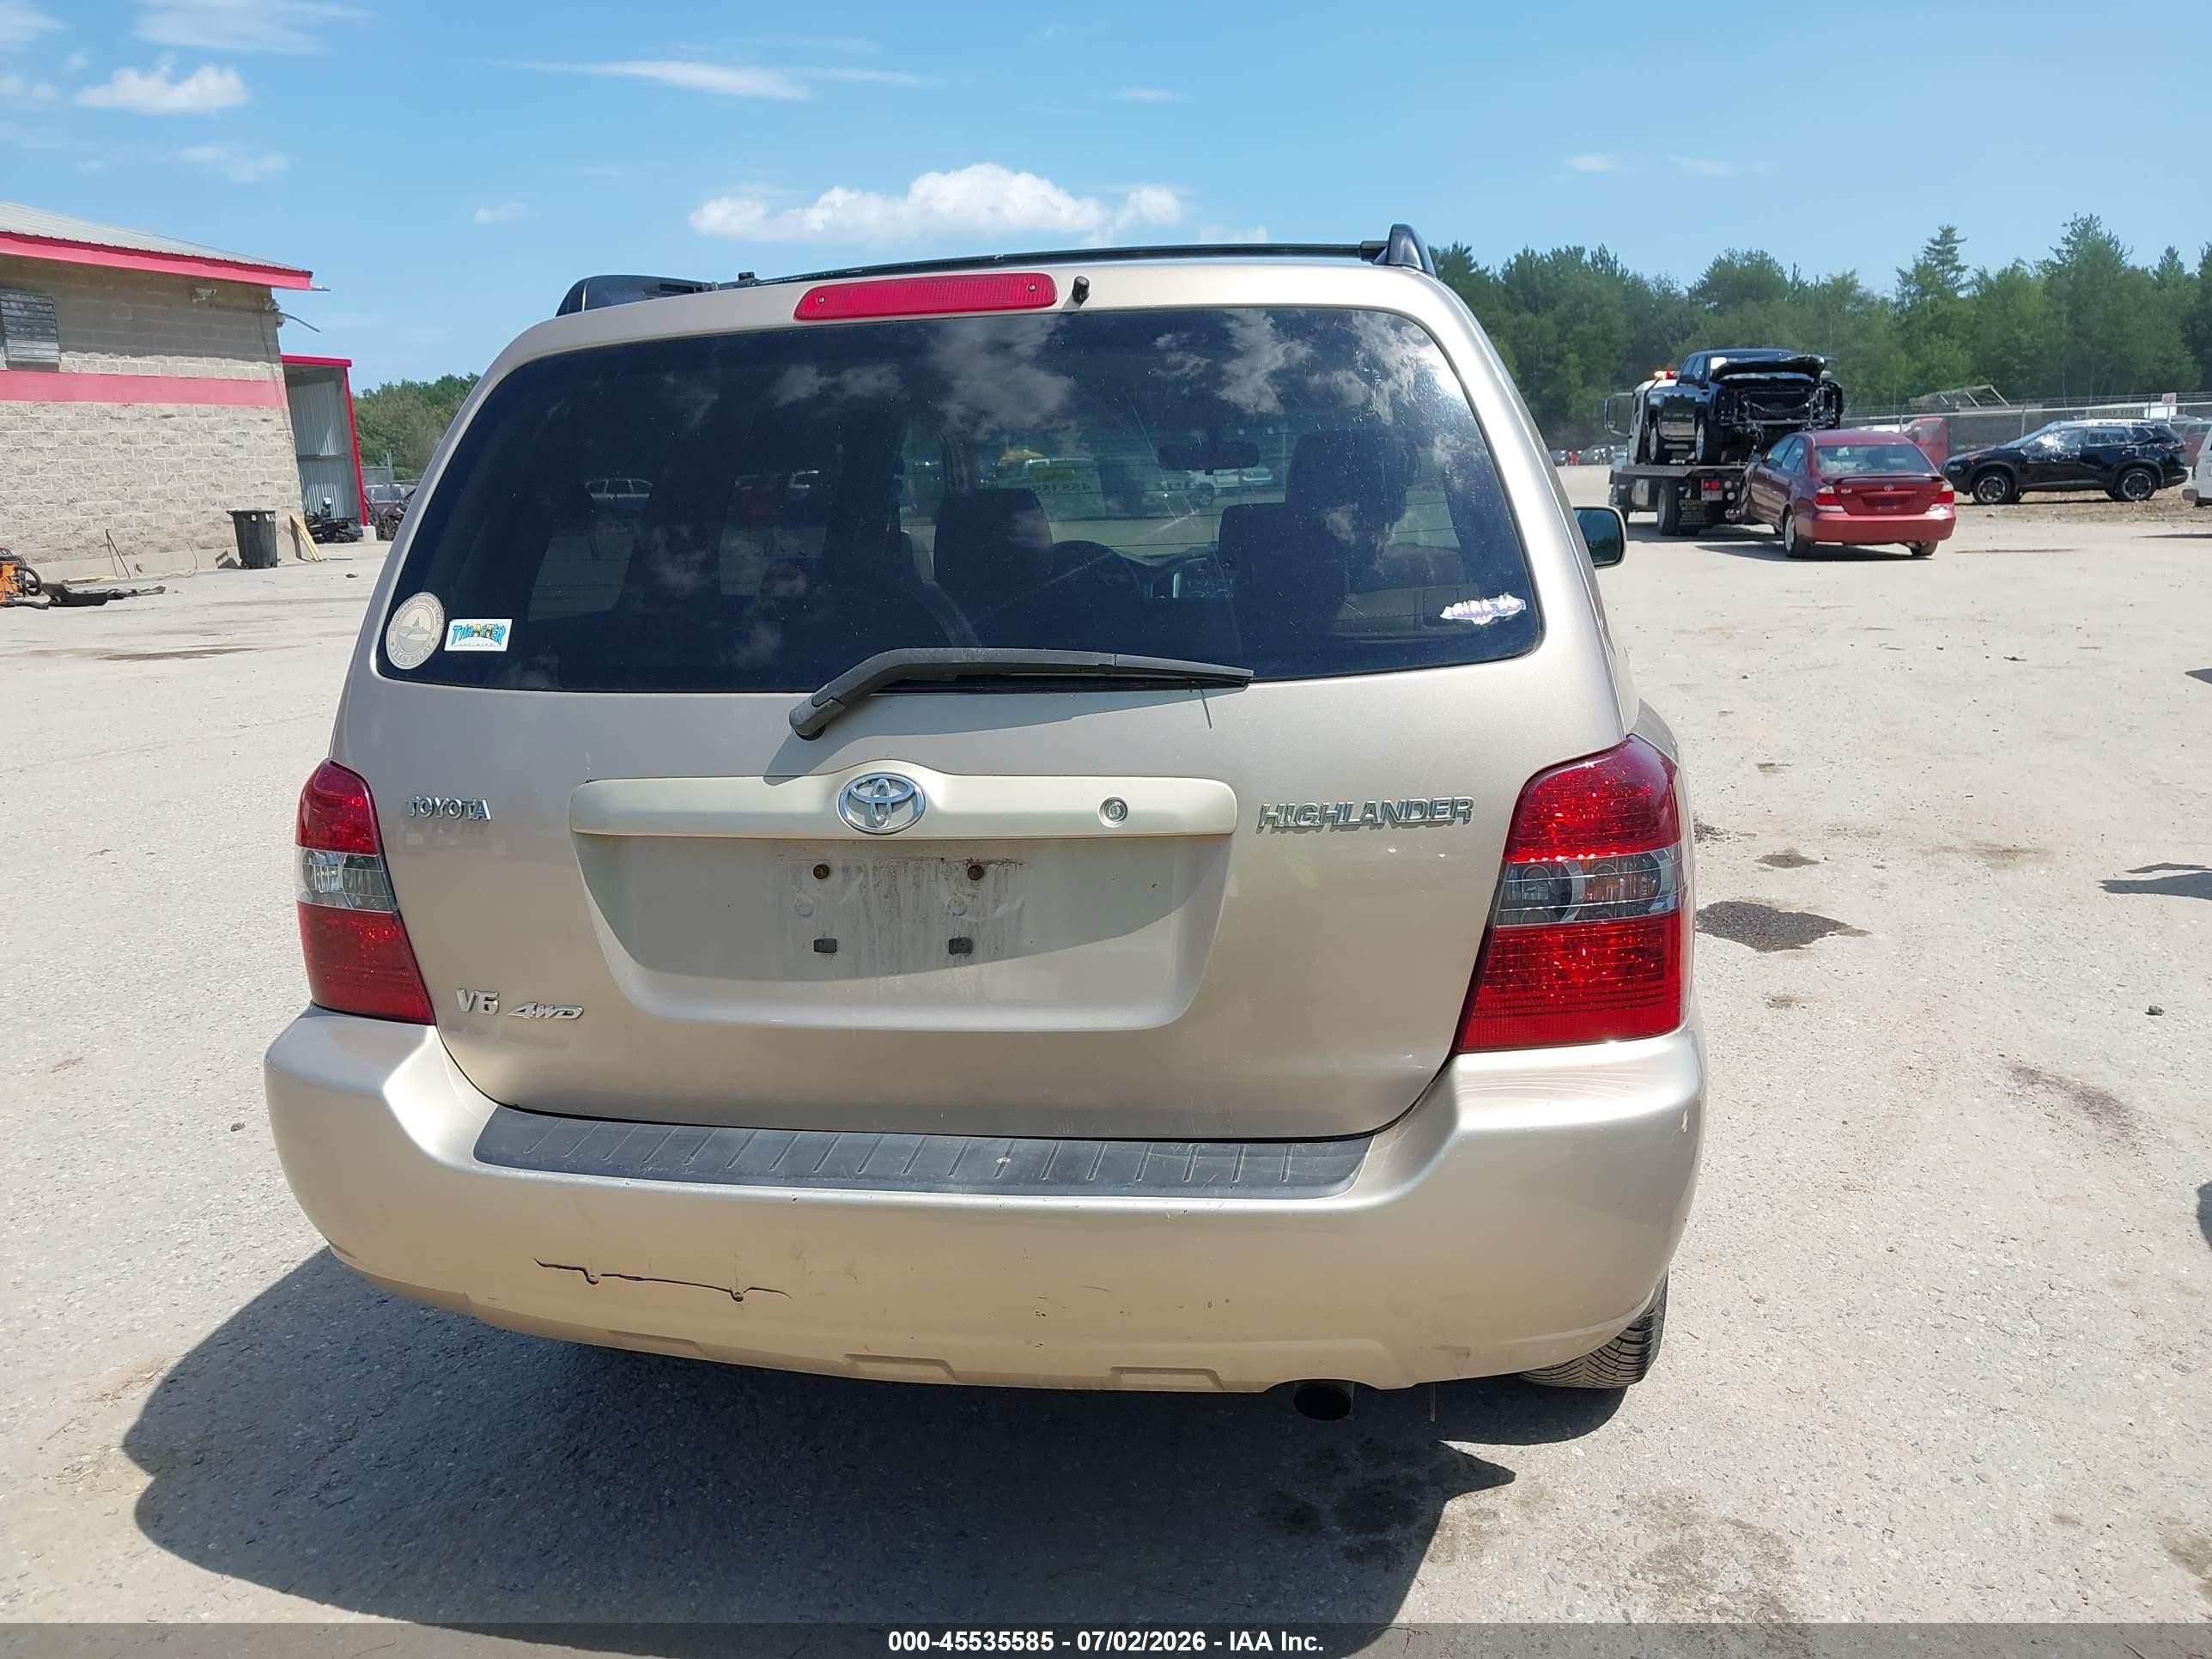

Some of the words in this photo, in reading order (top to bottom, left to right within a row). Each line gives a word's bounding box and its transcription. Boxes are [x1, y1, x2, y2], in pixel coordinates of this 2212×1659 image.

[451, 623, 507, 647] THRASHER
[405, 796, 492, 822] TOYOTA
[1259, 795, 1474, 830] HIGHLANDER
[455, 988, 500, 1016] V6
[507, 1001, 585, 1020] 4WD
